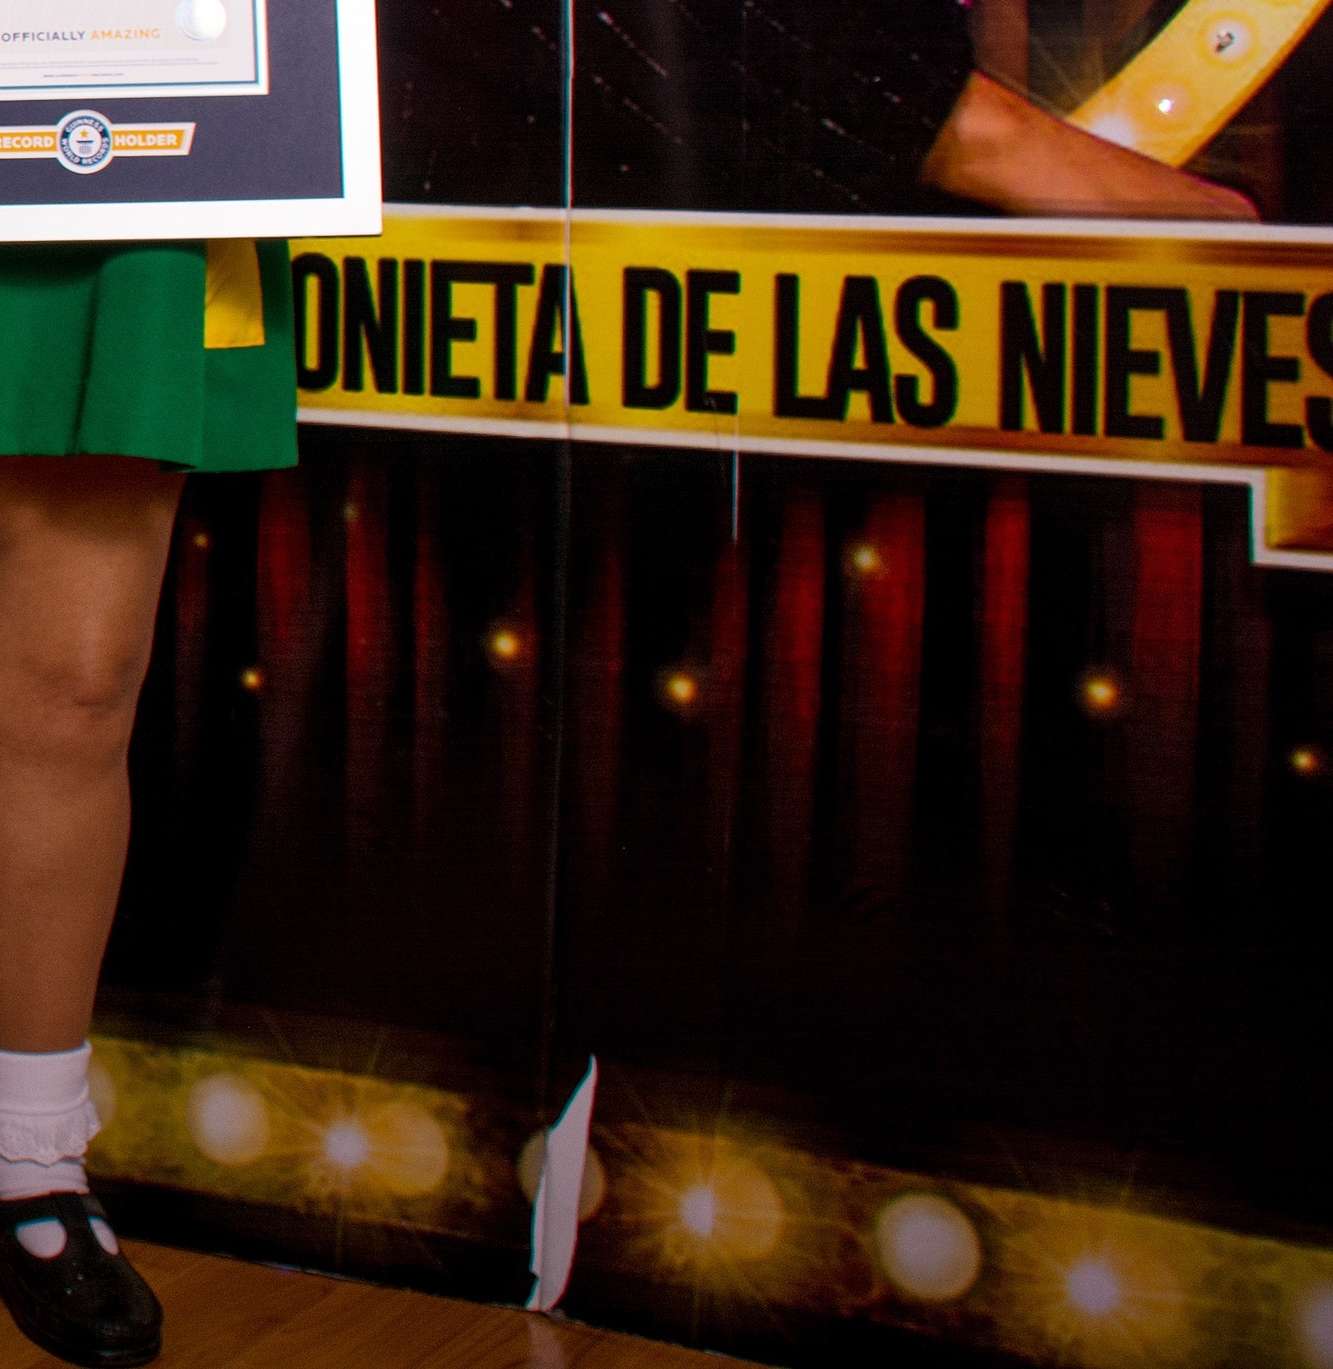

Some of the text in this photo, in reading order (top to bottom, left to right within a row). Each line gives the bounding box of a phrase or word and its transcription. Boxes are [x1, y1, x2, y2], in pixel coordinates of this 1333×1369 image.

[2, 29, 160, 42] OFFICIALLY AMAZING
[65, 119, 103, 132] GUINNESS
[115, 133, 177, 147] HOLDER
[62, 137, 109, 164] WORLD RECORDS
[621, 265, 741, 415] DE
[772, 273, 961, 427] LAS
